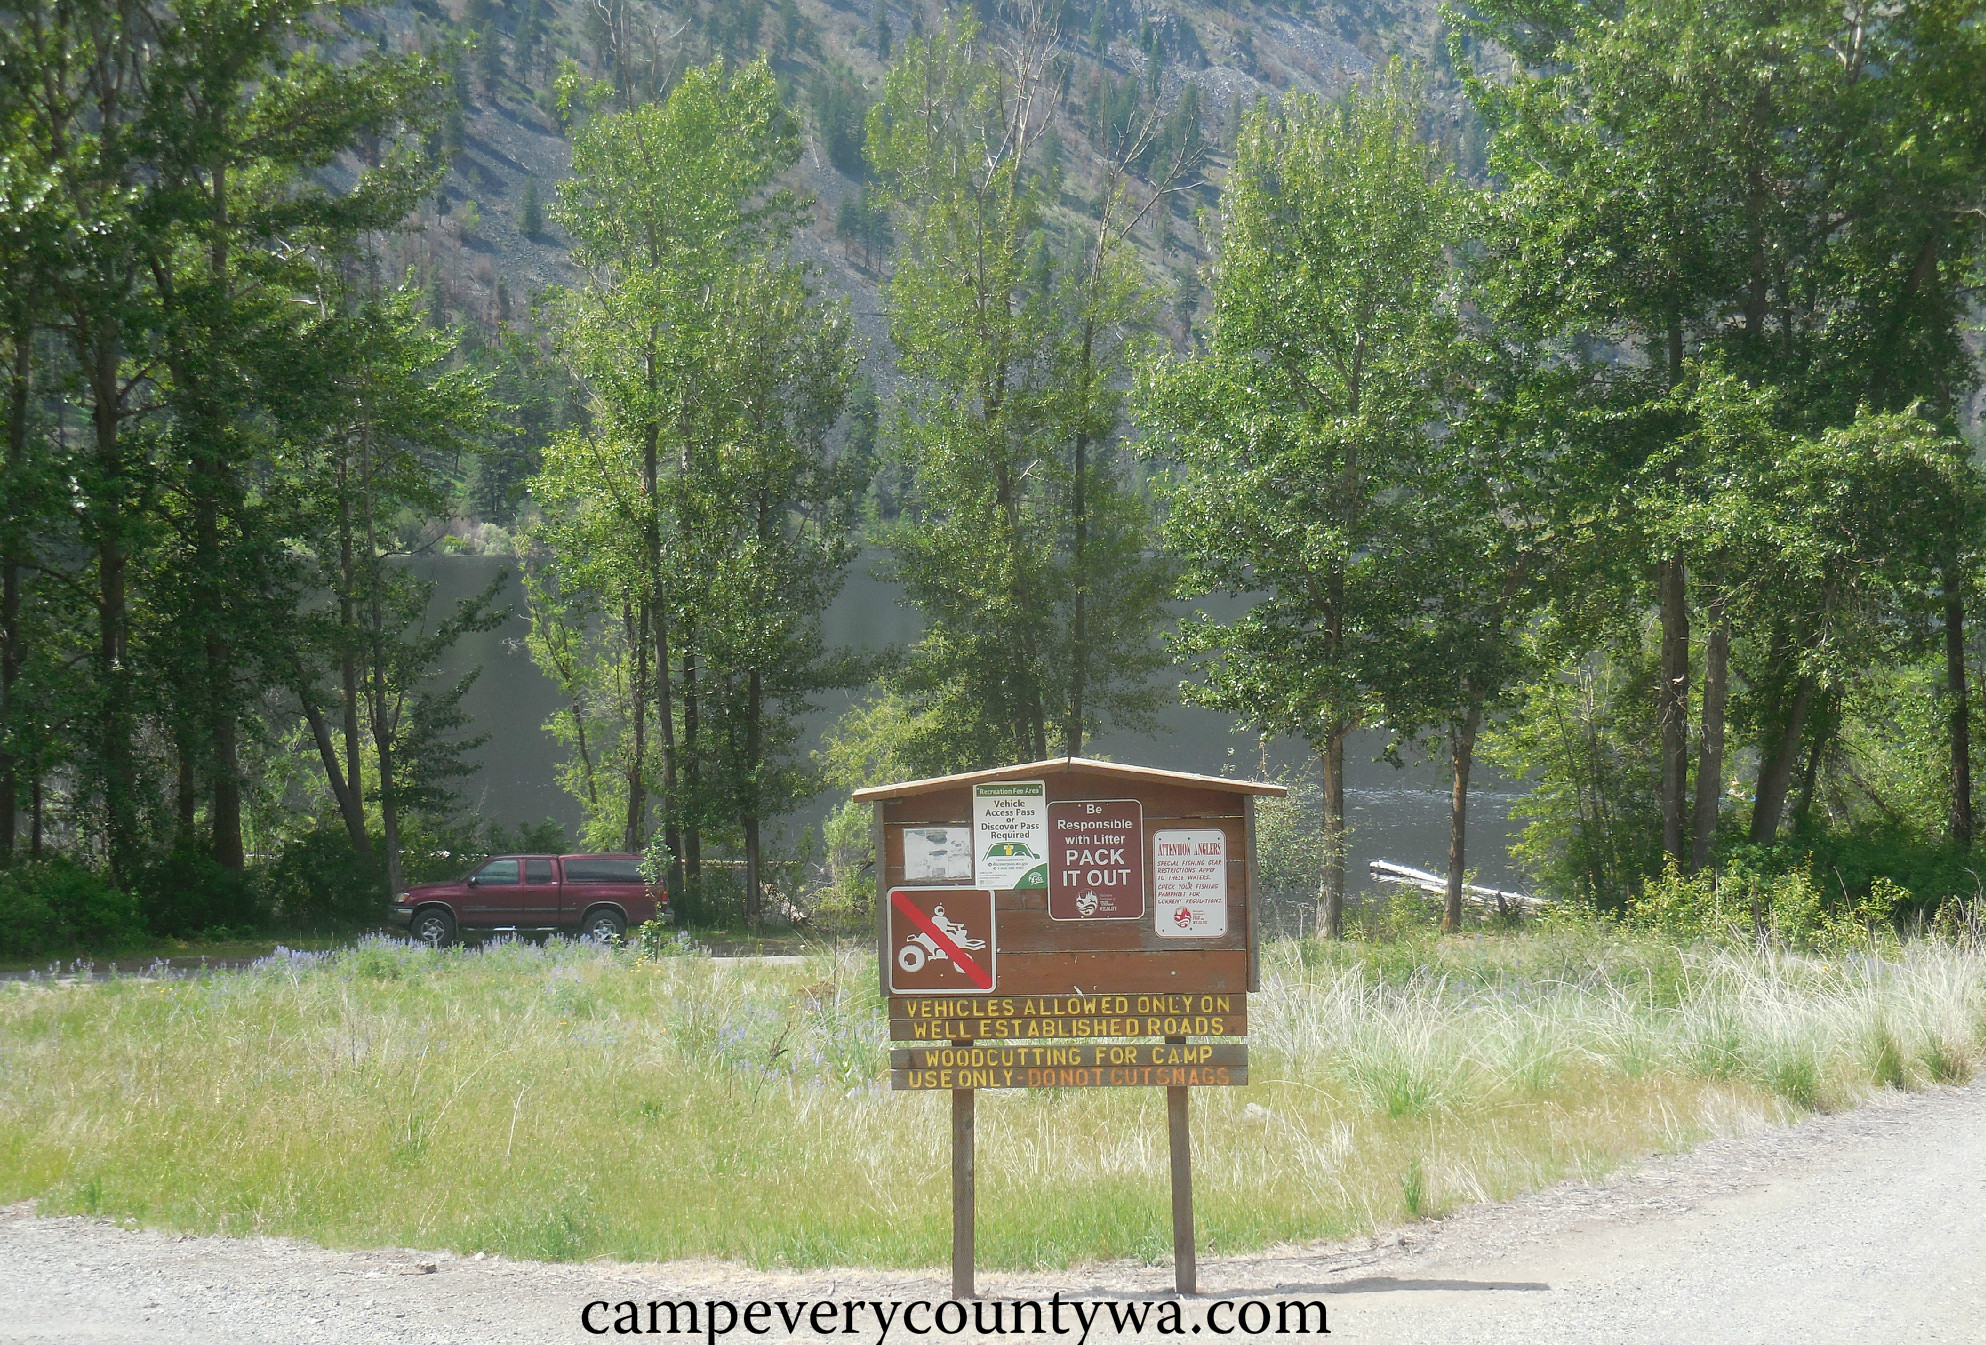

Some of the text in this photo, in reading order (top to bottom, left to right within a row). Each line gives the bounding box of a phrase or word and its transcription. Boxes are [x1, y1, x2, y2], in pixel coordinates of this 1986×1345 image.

[994, 799, 1025, 808] Vehicle
[1086, 804, 1102, 814] Be
[1057, 819, 1132, 831] Responsible
[991, 830, 1030, 841] Required
[1065, 835, 1125, 845] with Litter
[1158, 843, 1221, 856] ATTENTION ANGLERS
[1066, 849, 1125, 866] PACK
[1062, 870, 1081, 886] IT
[1087, 869, 1131, 886] OUT
[907, 995, 1230, 1018] VEHICLES ALLOWED ONLY ON
[913, 1017, 1224, 1039] WELL ESTABLISHED ROADS
[926, 1045, 1213, 1067] WOODCUTTING FOR CAMP
[908, 1069, 953, 1088] USE
[958, 1069, 1013, 1088] ONLY
[1110, 1067, 1152, 1085] CUT
[1156, 1067, 1230, 1085] SNAGS
